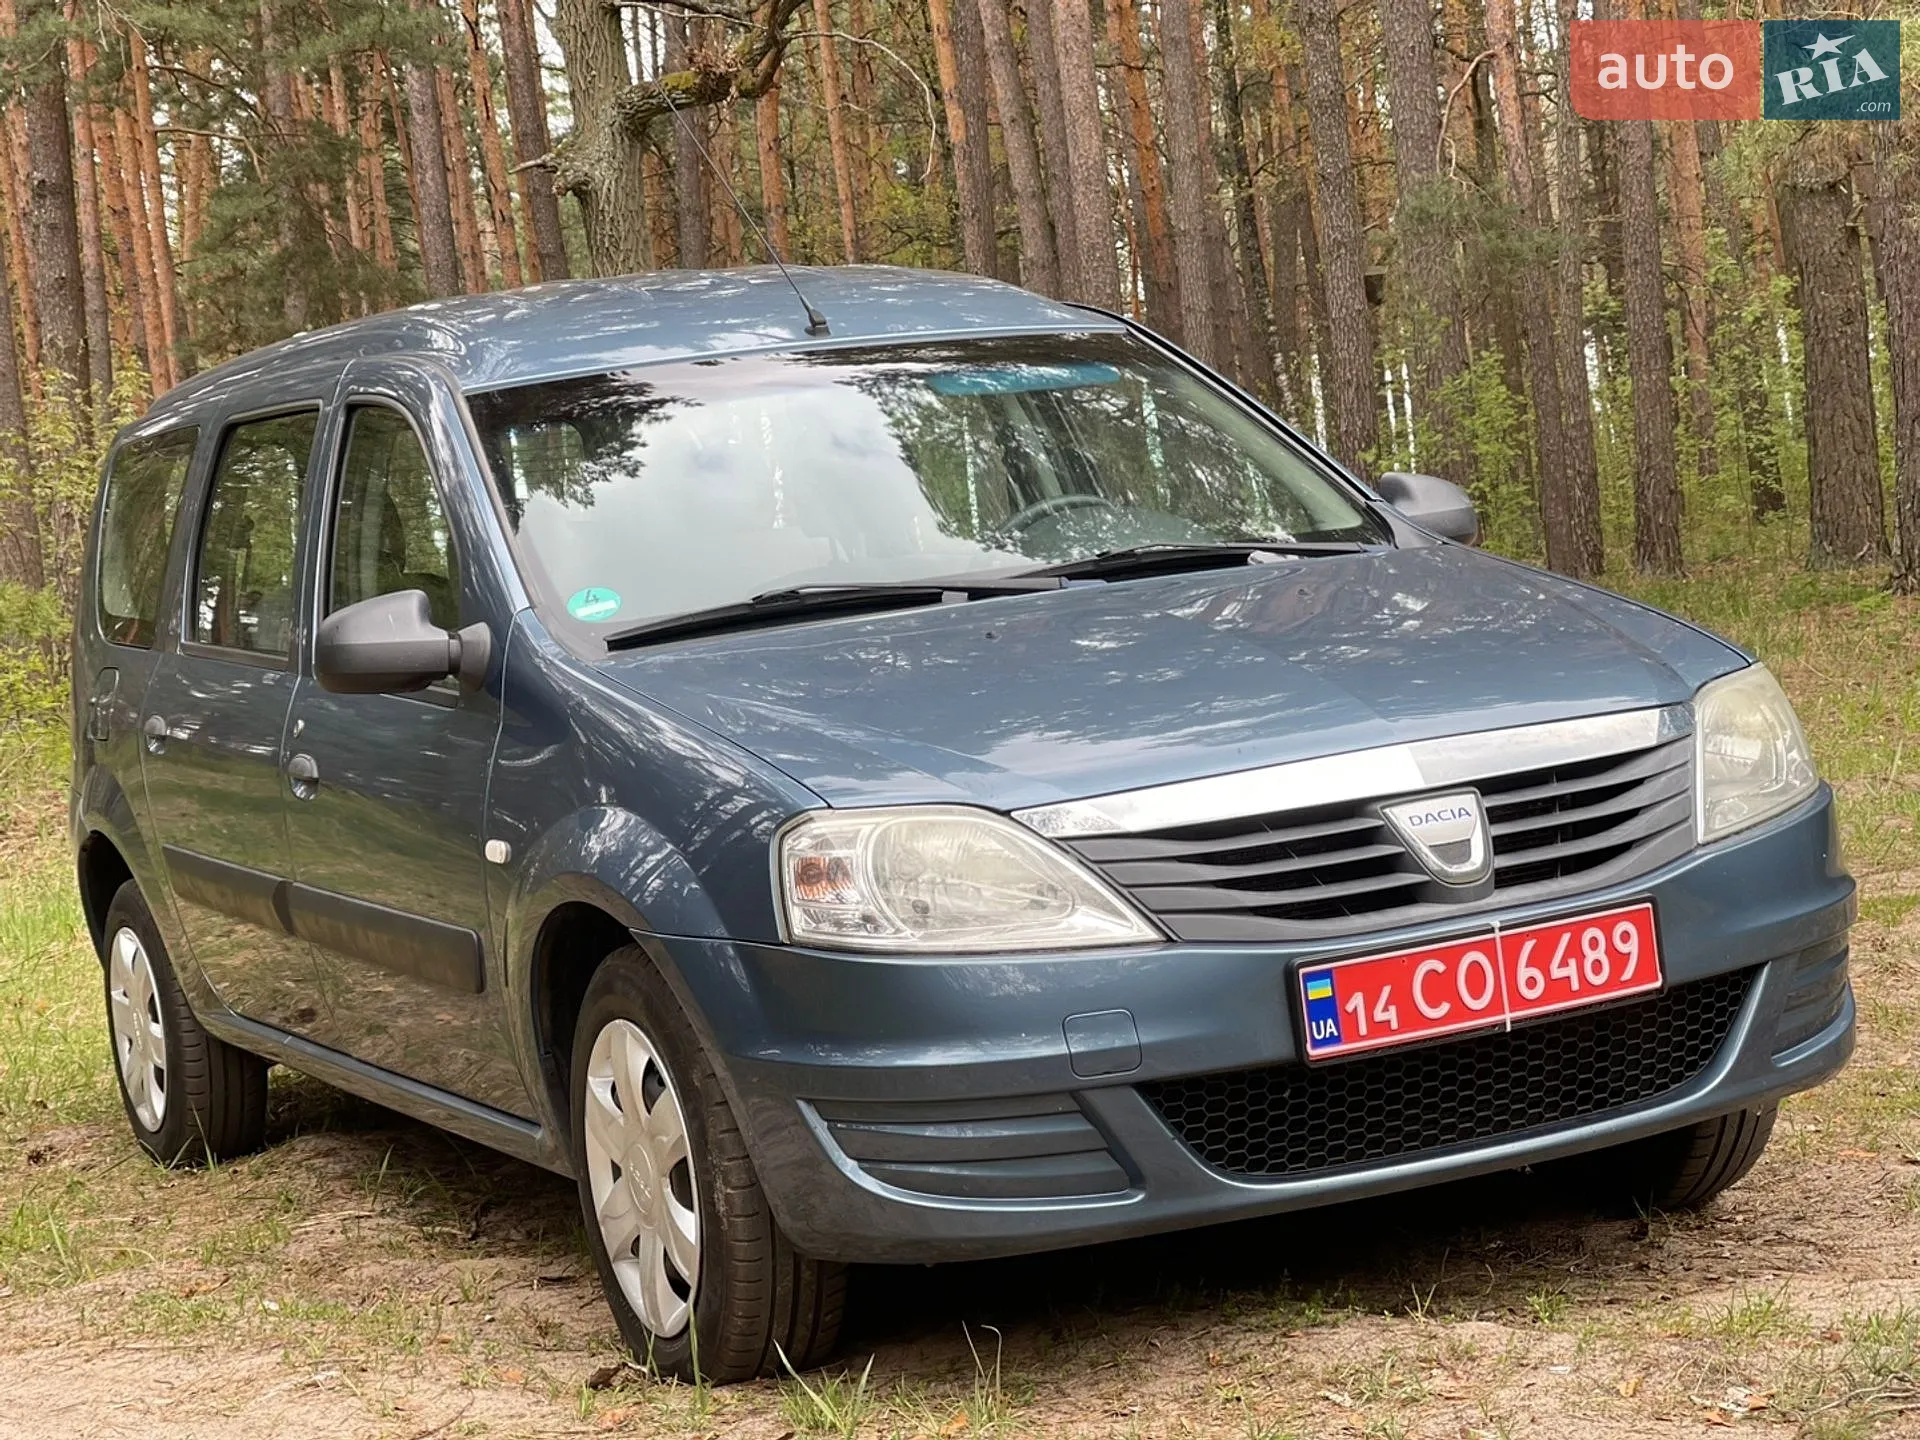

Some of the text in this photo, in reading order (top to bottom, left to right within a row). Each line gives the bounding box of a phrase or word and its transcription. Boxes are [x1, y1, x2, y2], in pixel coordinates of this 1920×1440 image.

[1408, 807, 1472, 827] DACIA
[1345, 920, 1639, 1036] 14 CO 6489
[1312, 1018, 1338, 1039] UA
